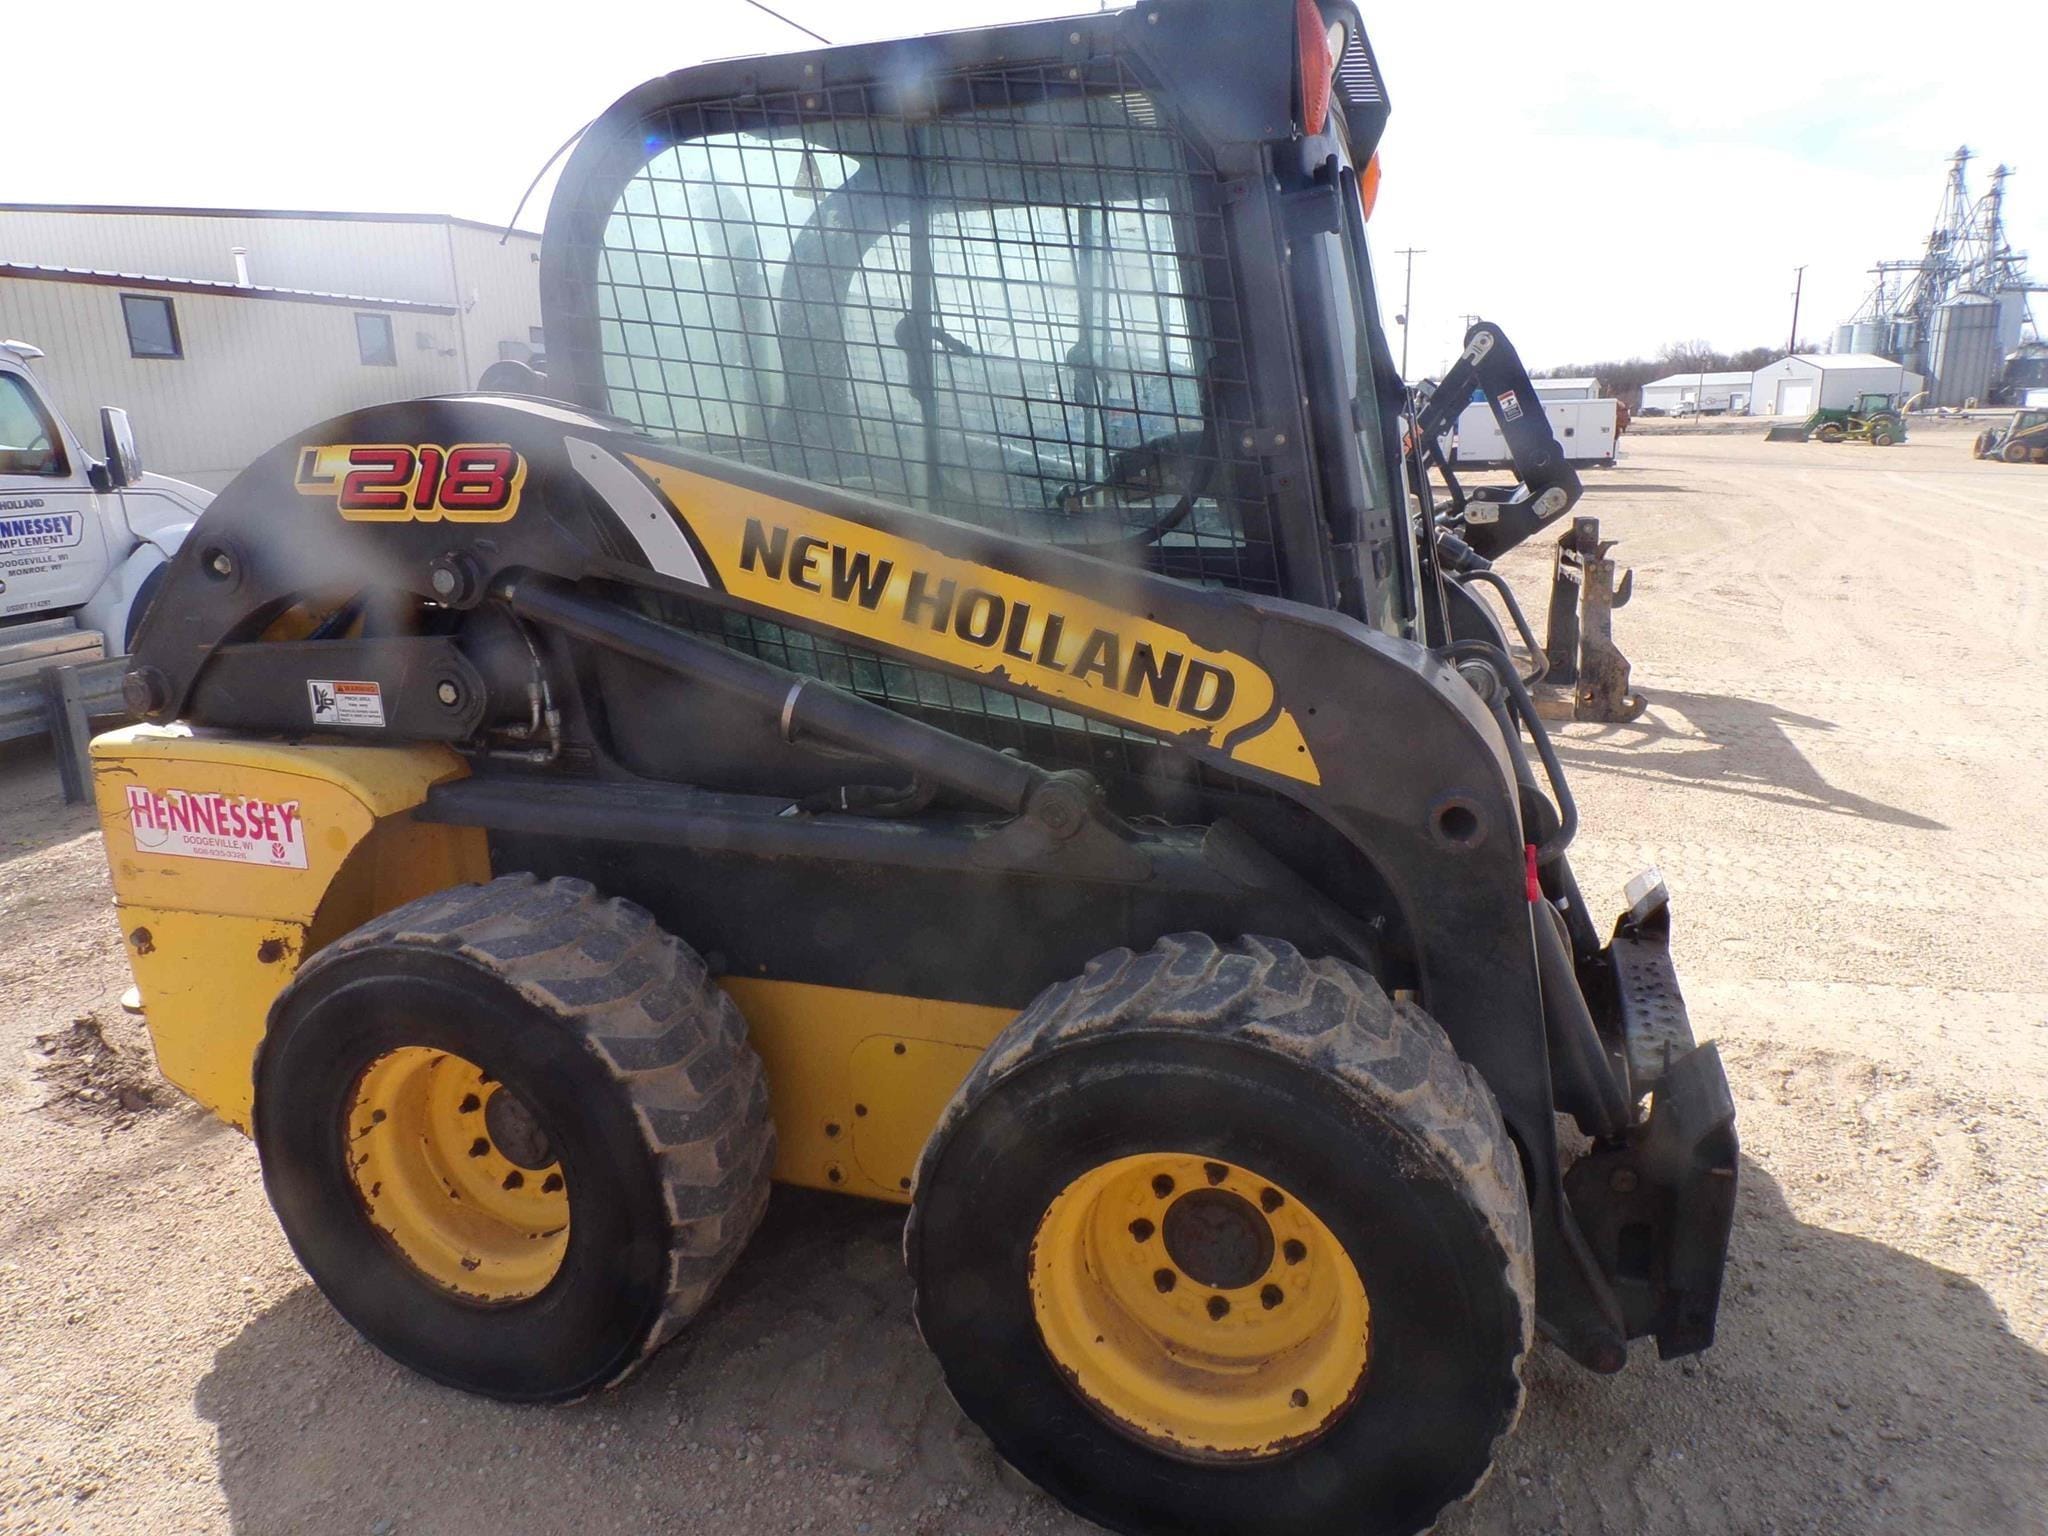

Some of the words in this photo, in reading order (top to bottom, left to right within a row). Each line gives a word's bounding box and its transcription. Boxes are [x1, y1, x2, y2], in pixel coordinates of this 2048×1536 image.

[296, 446, 522, 517] L218
[738, 517, 893, 611] NEW
[902, 567, 1236, 723] HOLLAND
[131, 790, 295, 843] HENNESSEY
[242, 841, 254, 850] WI
